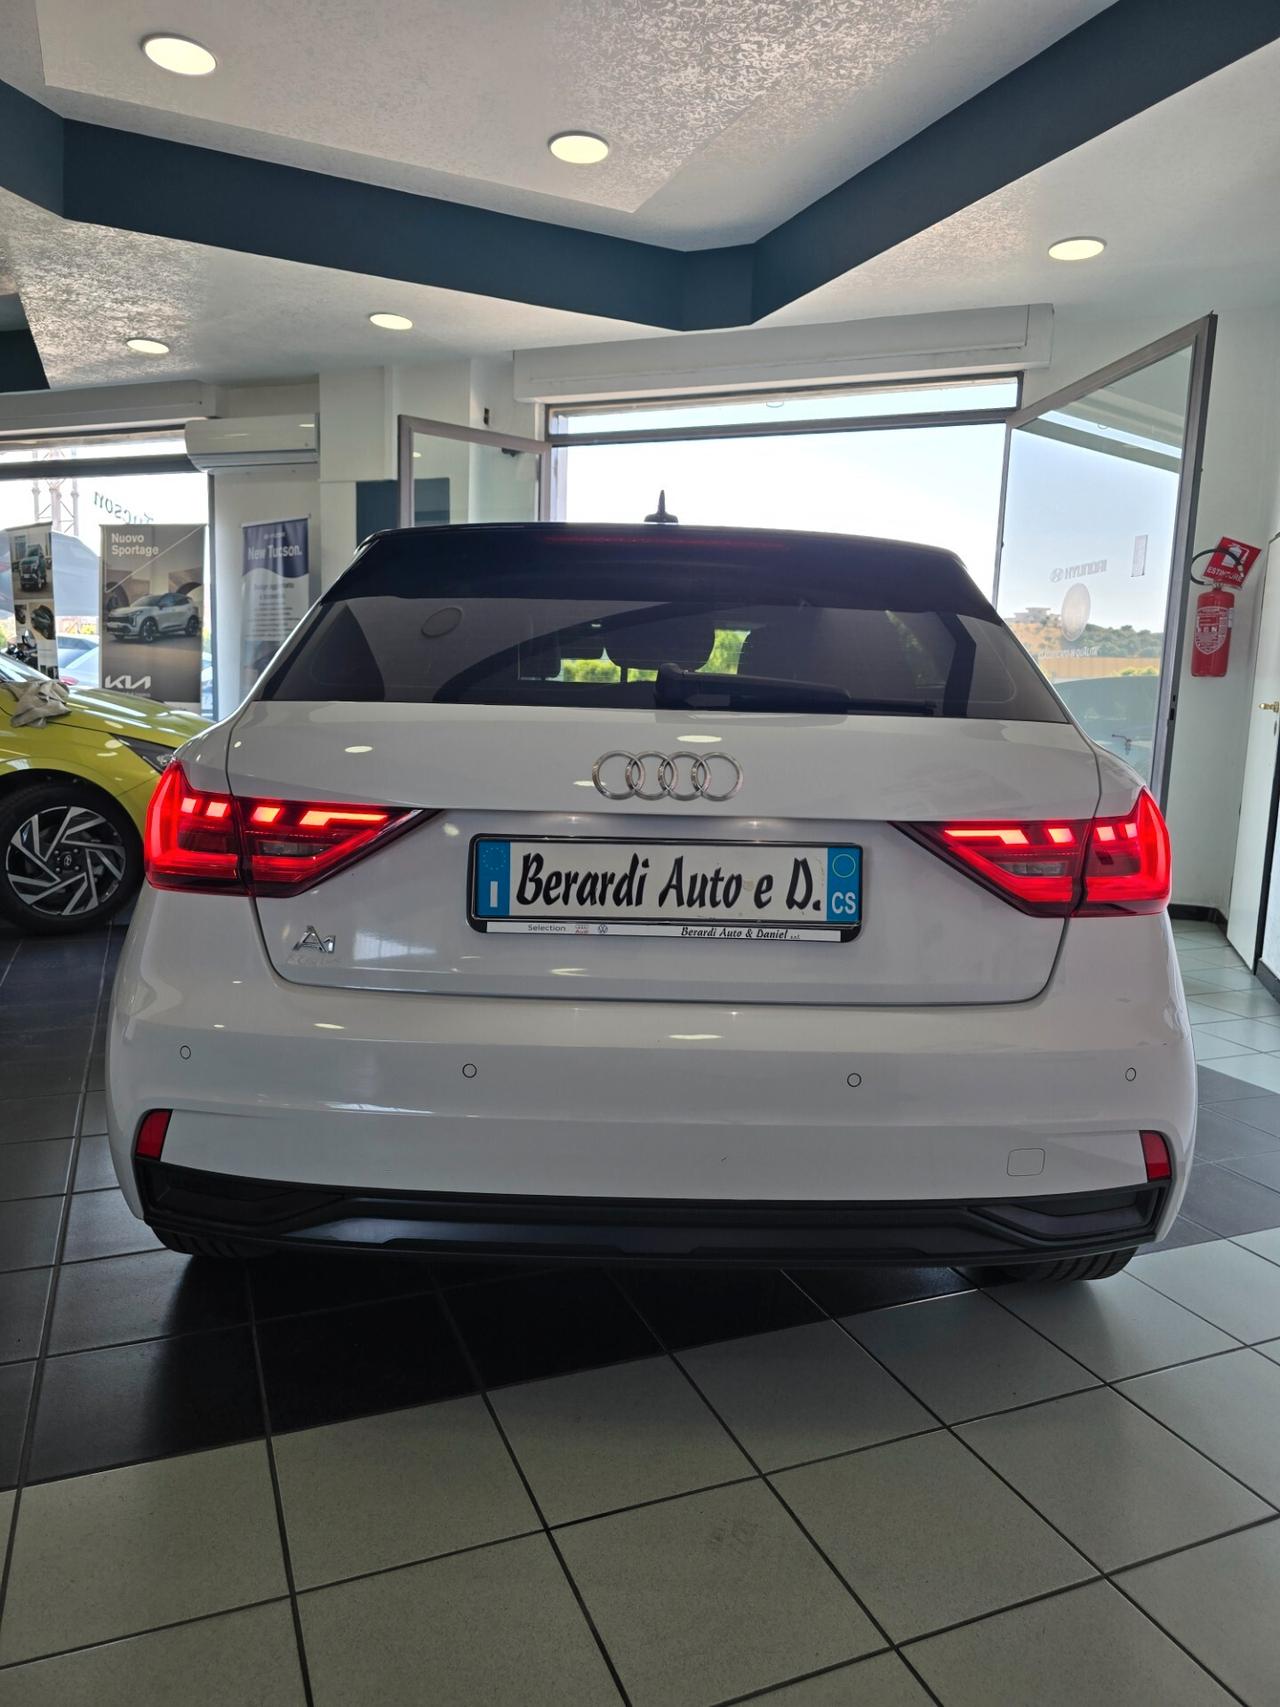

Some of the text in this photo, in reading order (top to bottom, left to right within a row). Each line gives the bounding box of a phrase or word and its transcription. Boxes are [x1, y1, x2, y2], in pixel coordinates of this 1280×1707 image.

[111, 533, 145, 544] Nuovo
[111, 545, 159, 557] Sportage
[247, 547, 266, 561] New
[1064, 560, 1108, 580] HYUNDAI
[104, 674, 152, 690] KIA
[516, 853, 821, 911] Berardi Auto e D.
[831, 892, 857, 914] CS
[528, 924, 566, 932] Selection
[680, 926, 717, 938] Berardi
[719, 928, 742, 938] Auto
[745, 929, 753, 939] &
[756, 929, 789, 940] Daniel
[292, 925, 336, 954] A1
